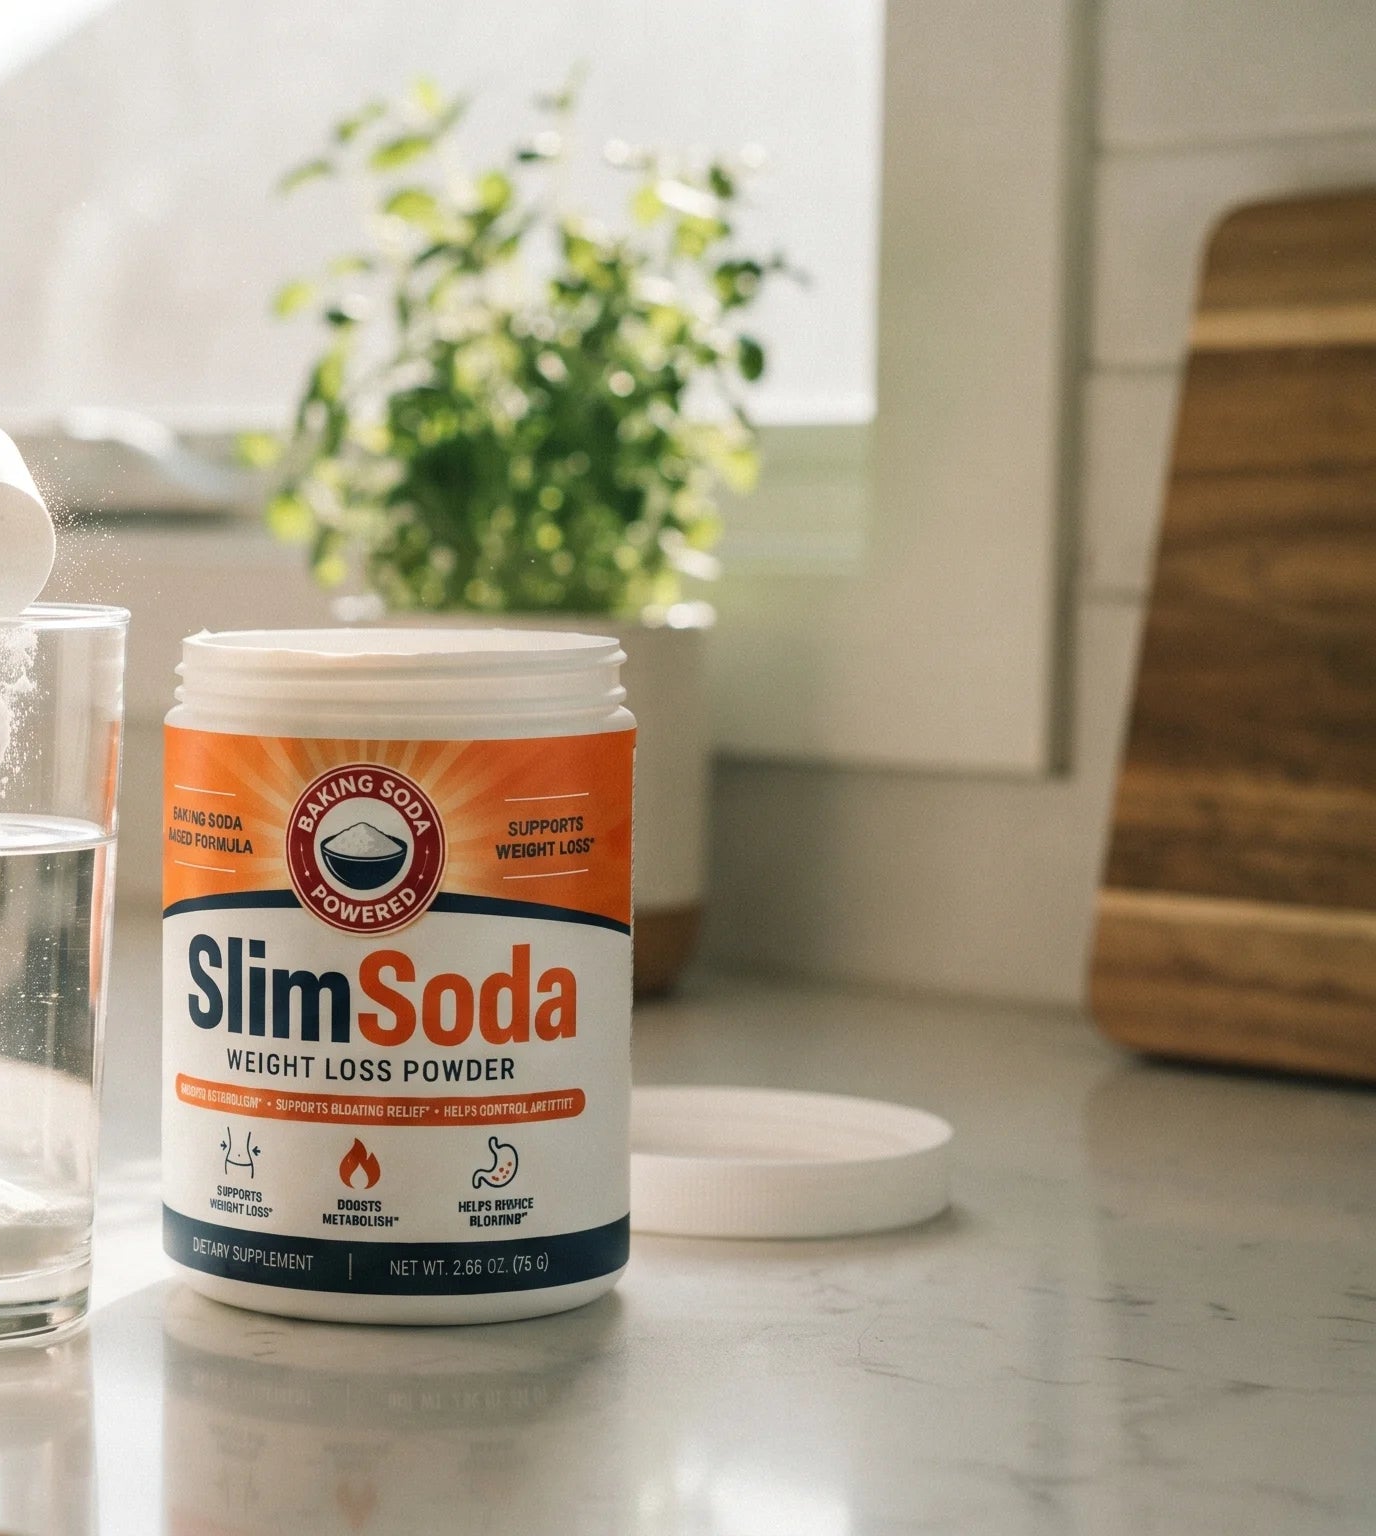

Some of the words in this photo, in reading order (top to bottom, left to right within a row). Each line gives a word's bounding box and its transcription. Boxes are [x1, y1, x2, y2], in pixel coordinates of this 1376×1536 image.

[297, 774, 373, 833] BAKING
[379, 780, 431, 837] SODA
[208, 812, 243, 832] SODA
[507, 816, 584, 837] SUPPORTS
[195, 833, 254, 854] FORMULA
[495, 841, 555, 860] WEIGHT
[310, 884, 417, 924] POWERED
[188, 933, 577, 1047] SlimSoda
[226, 1048, 316, 1079] WEIGHT
[325, 1057, 392, 1082] LOSS
[403, 1057, 515, 1083] POWDER
[275, 1098, 328, 1114] SUPPORTS
[444, 1104, 477, 1117] HELPS
[216, 1184, 263, 1203] SUPPORTS
[458, 1199, 492, 1212] HELPS
[232, 1245, 314, 1271] SUPPLEMENT
[390, 1259, 419, 1276] NET
[422, 1259, 448, 1276] WT.
[453, 1258, 483, 1276] 2.66
[487, 1257, 509, 1275] OZ.
[512, 1253, 532, 1275] (75
[536, 1251, 549, 1272] G)
